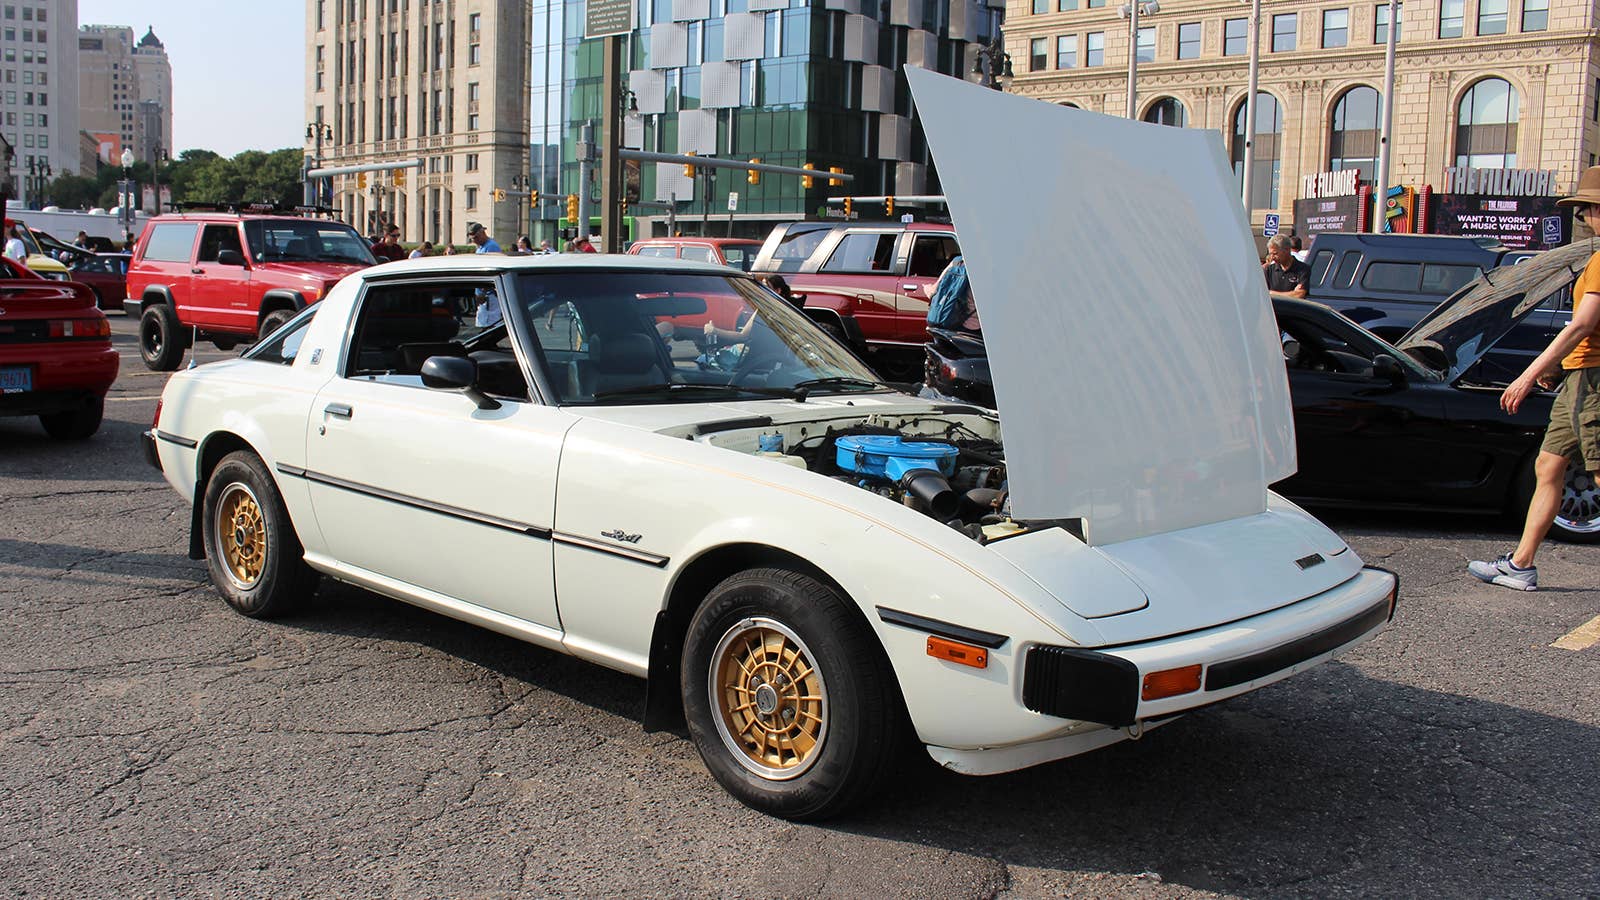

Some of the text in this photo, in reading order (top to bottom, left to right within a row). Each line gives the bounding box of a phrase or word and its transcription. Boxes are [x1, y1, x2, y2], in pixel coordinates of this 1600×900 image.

[1303, 169, 1358, 199] THE FILLMORE
[1447, 166, 1559, 196] THE FILLMORE
[1484, 215, 1496, 223] TO
[1497, 216, 1526, 224] WORK
[1498, 223, 1533, 231] VENUE?
